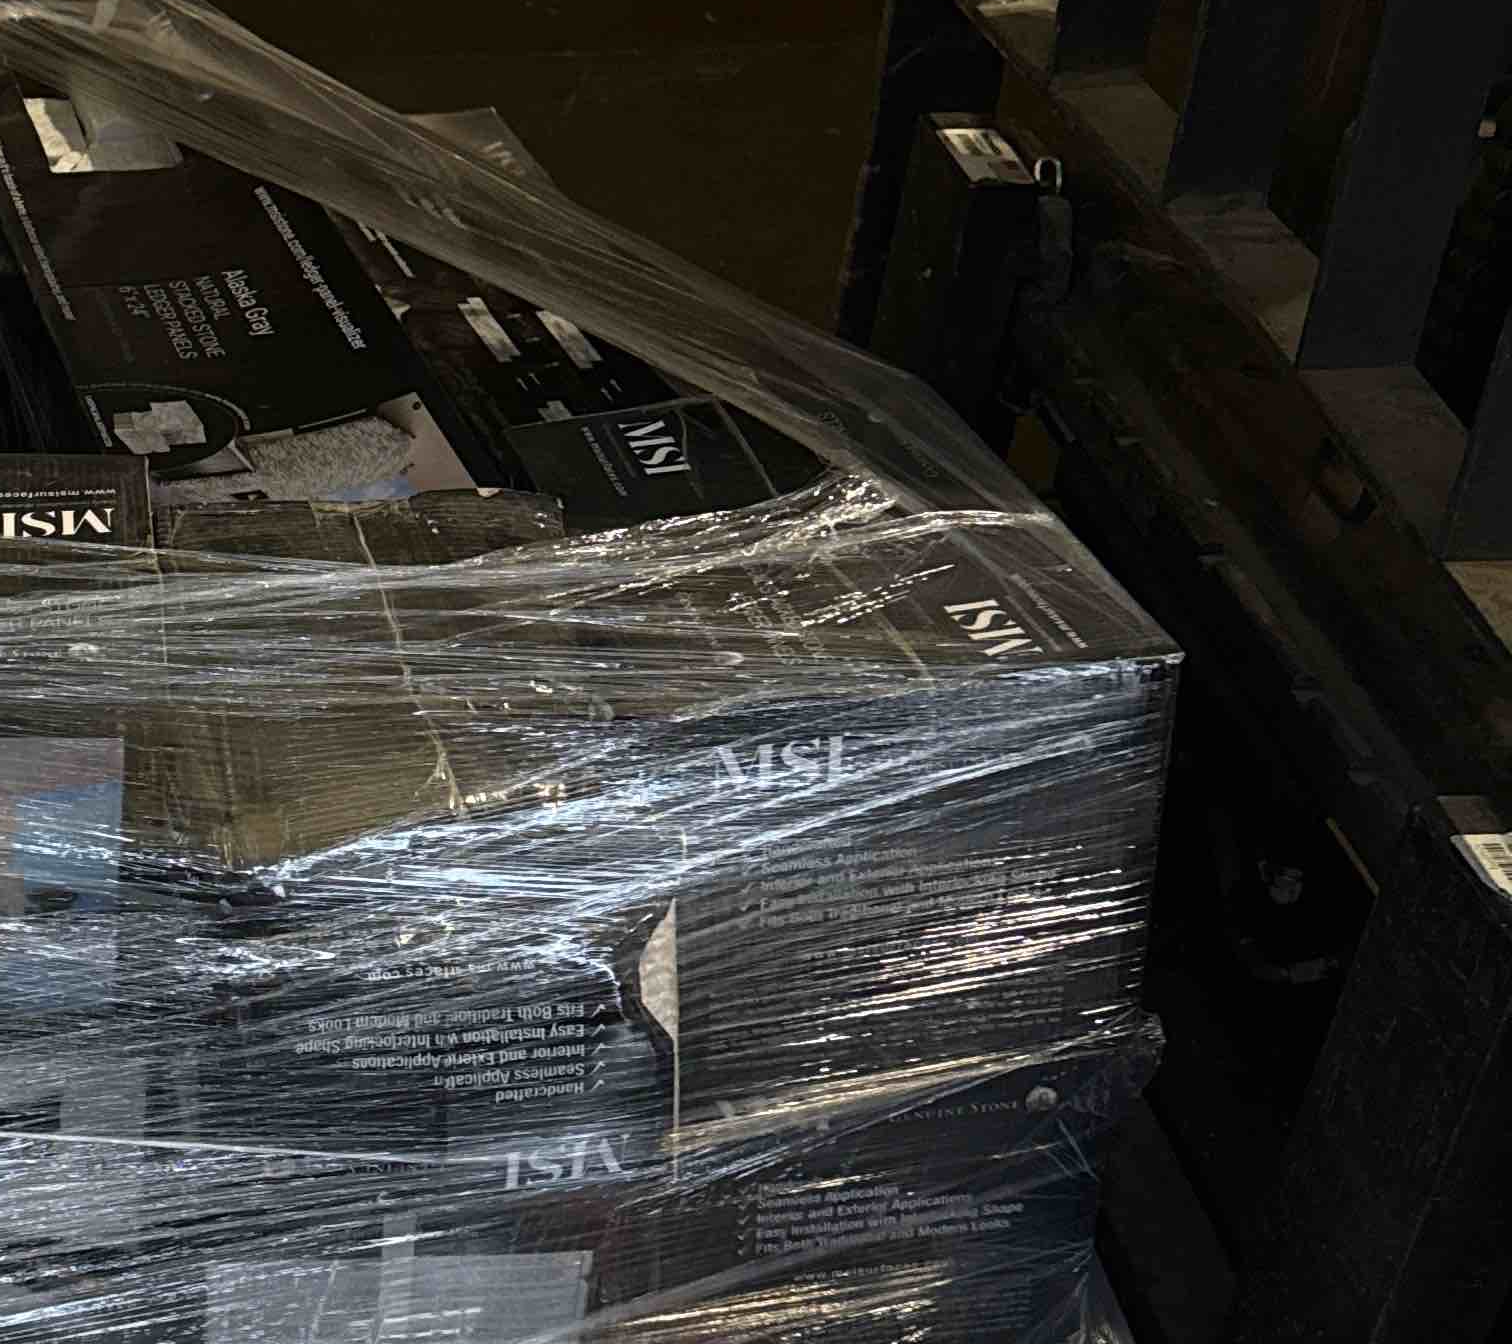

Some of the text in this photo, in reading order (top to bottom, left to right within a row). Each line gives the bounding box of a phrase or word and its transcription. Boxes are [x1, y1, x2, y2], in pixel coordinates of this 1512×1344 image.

[194, 274, 233, 321] NATURAL
[220, 268, 277, 338] Alaska Gray
[168, 279, 227, 359] STACKED STONE
[617, 417, 693, 478] MSI
[1, 507, 116, 538] MSI
[944, 599, 1045, 657] MSI
[463, 1027, 545, 1044] Installation
[549, 1022, 585, 1039] Easy
[351, 1042, 585, 1072] Interior and Applications
[514, 1062, 585, 1081] Seamless
[495, 1081, 585, 1104] Handcrafted
